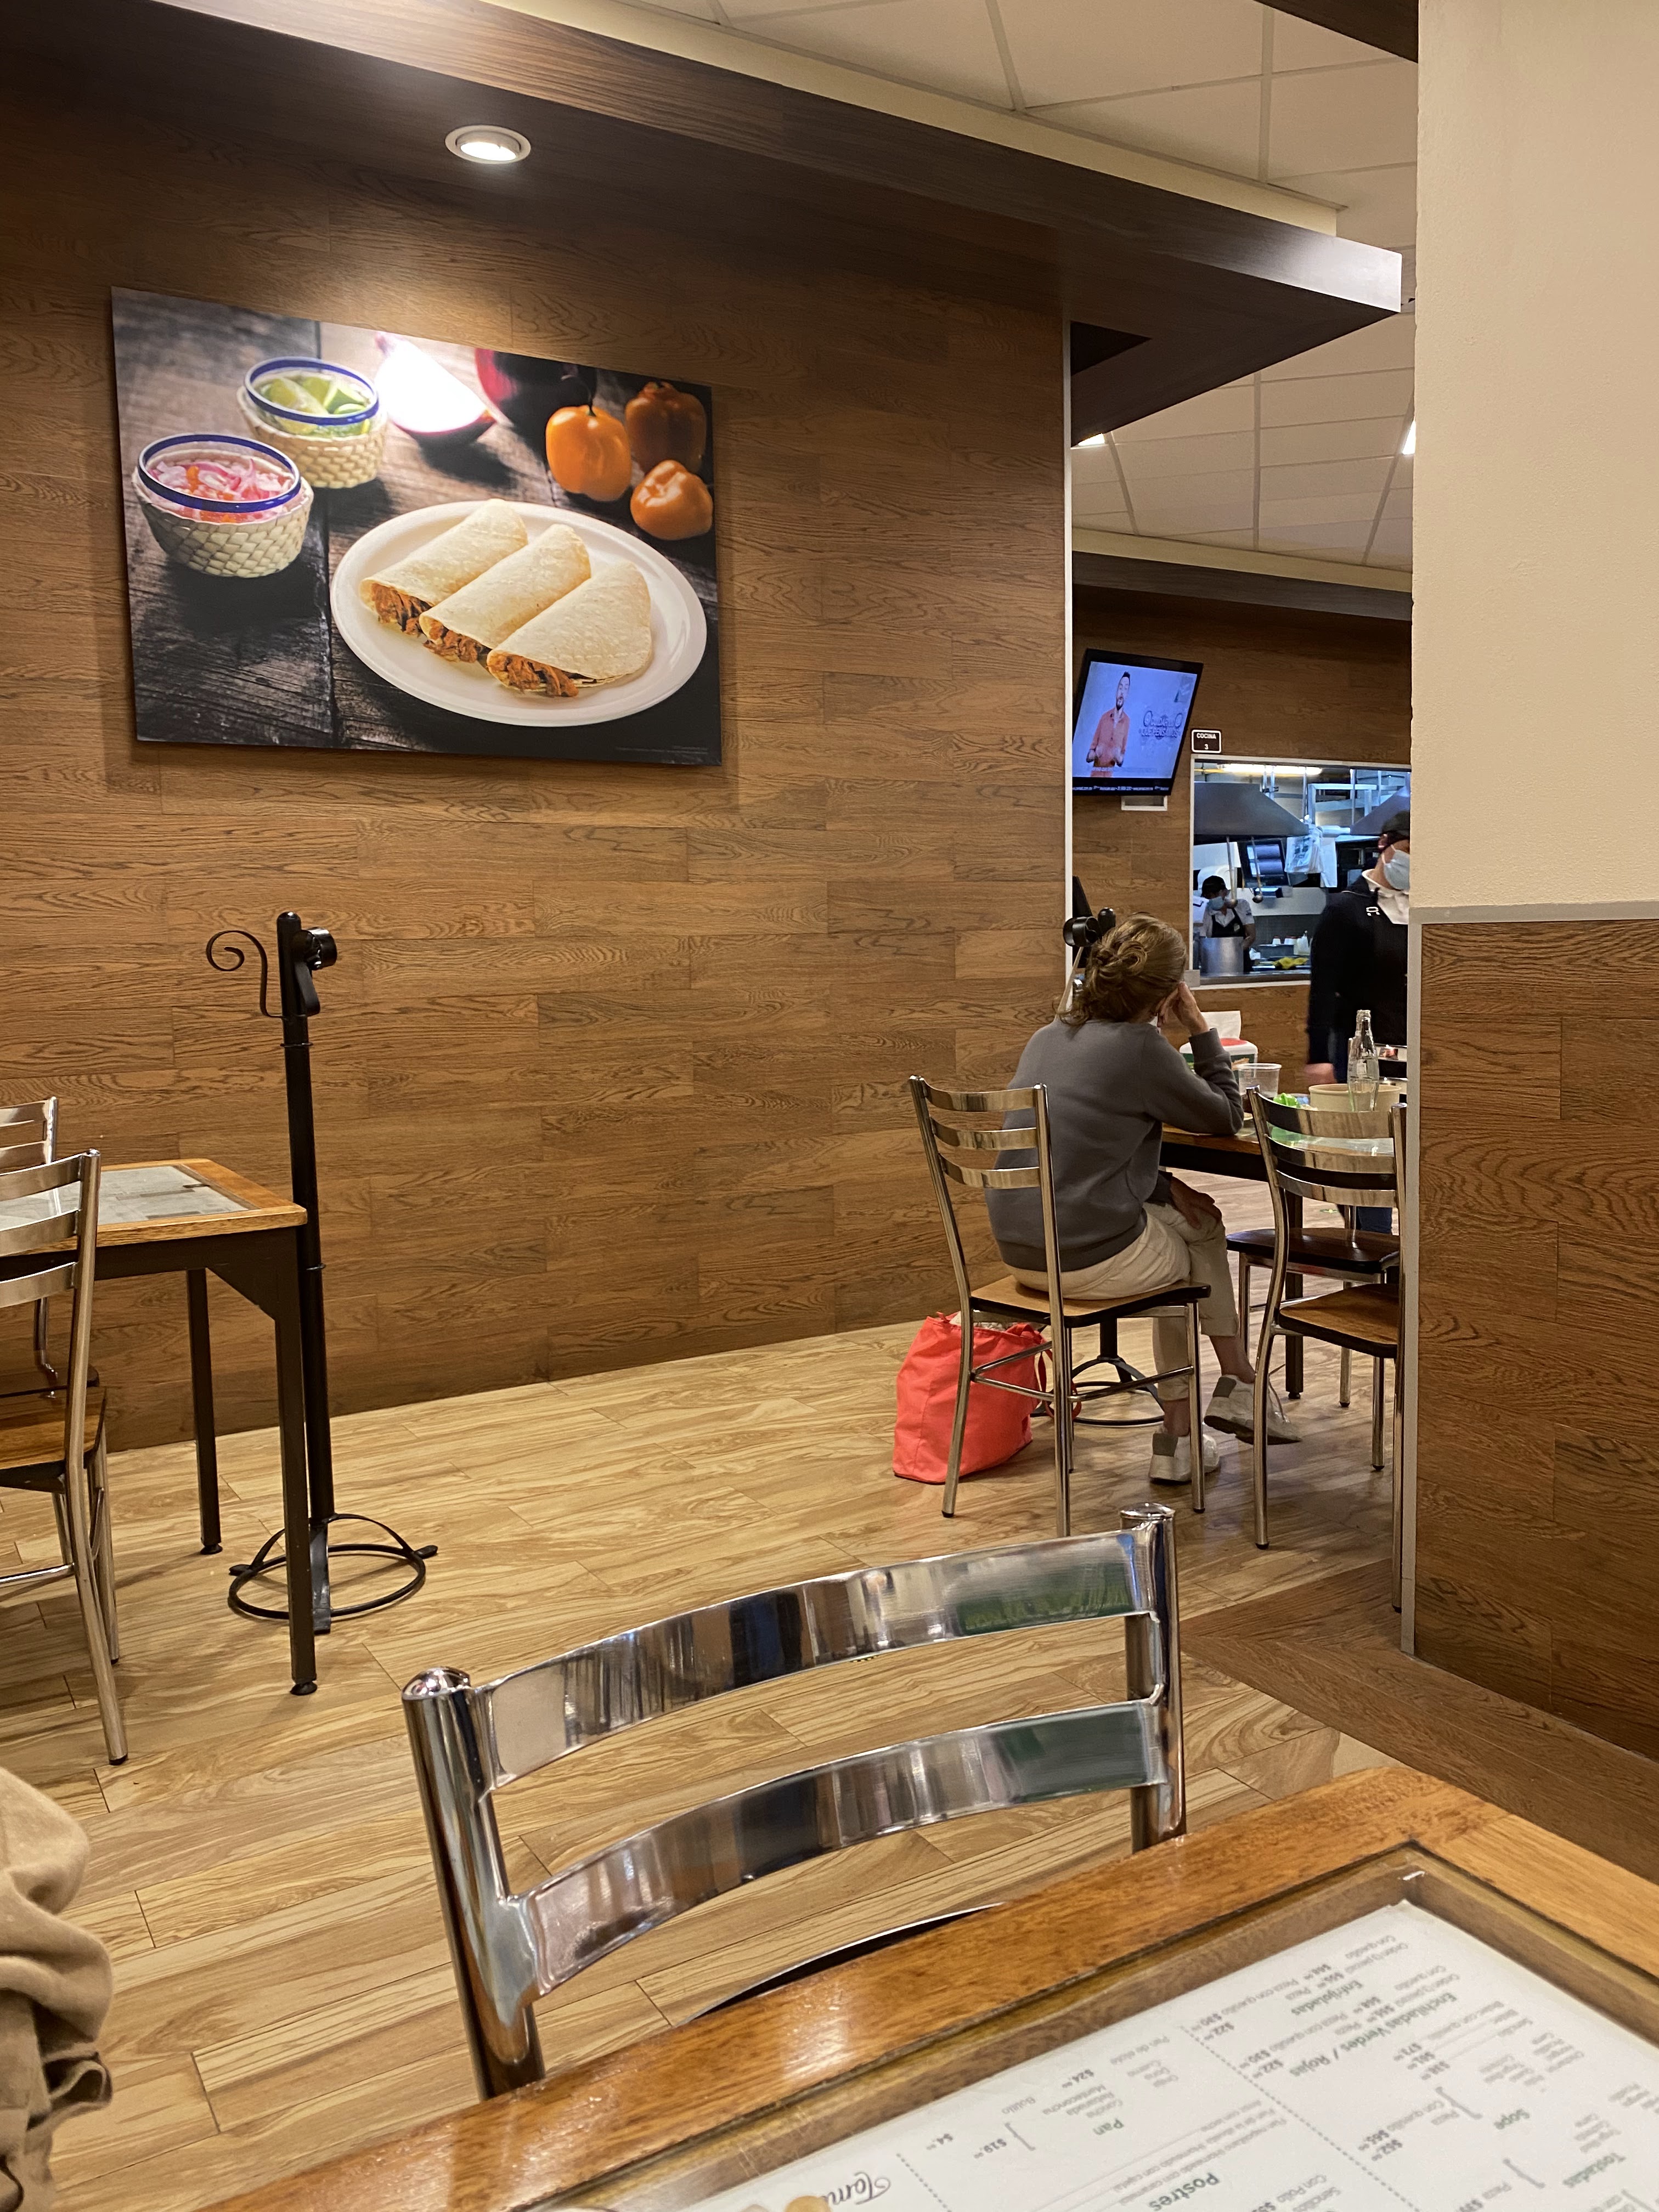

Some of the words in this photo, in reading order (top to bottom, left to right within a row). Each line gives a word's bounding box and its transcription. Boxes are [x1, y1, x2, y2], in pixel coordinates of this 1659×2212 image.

[1291, 1980, 1363, 2015] Enfrijoladas
[1385, 1992, 1457, 2028] Enchiladas
[1340, 2027, 1390, 2051] Verdes
[1289, 2055, 1331, 2076] Rojas
[1093, 2118, 1124, 2135] Pan
[1493, 2108, 1530, 2130] Sope
[1562, 2152, 1626, 2188] Tostadas
[1149, 2172, 1219, 2211] Postres
